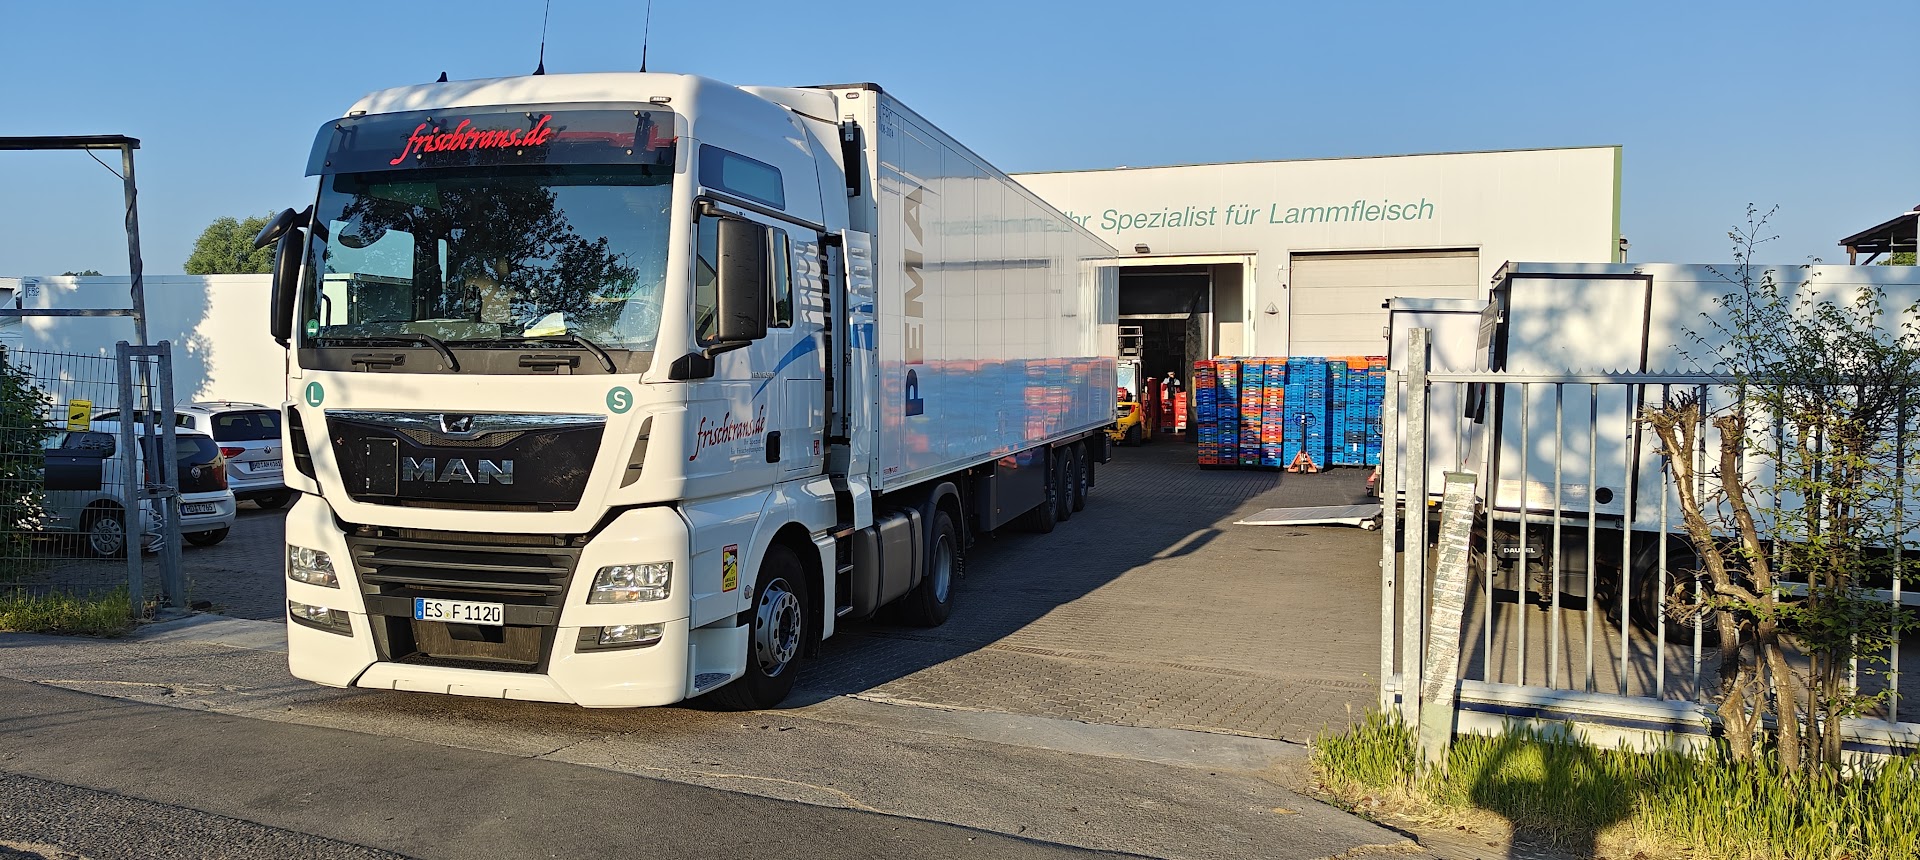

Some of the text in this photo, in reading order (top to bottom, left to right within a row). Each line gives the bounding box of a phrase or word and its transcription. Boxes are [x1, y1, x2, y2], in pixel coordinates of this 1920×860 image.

[389, 114, 552, 165] frischtrans.de
[1100, 206, 1218, 234] Spezialist
[1225, 204, 1260, 226] für
[1269, 198, 1434, 224] Lammfleisch
[904, 186, 924, 417] PEMA
[310, 386, 320, 403] L
[613, 391, 627, 410] S
[689, 404, 765, 461] frischtrans.de
[402, 457, 514, 485] MAN
[425, 602, 501, 622] ES F 1120
